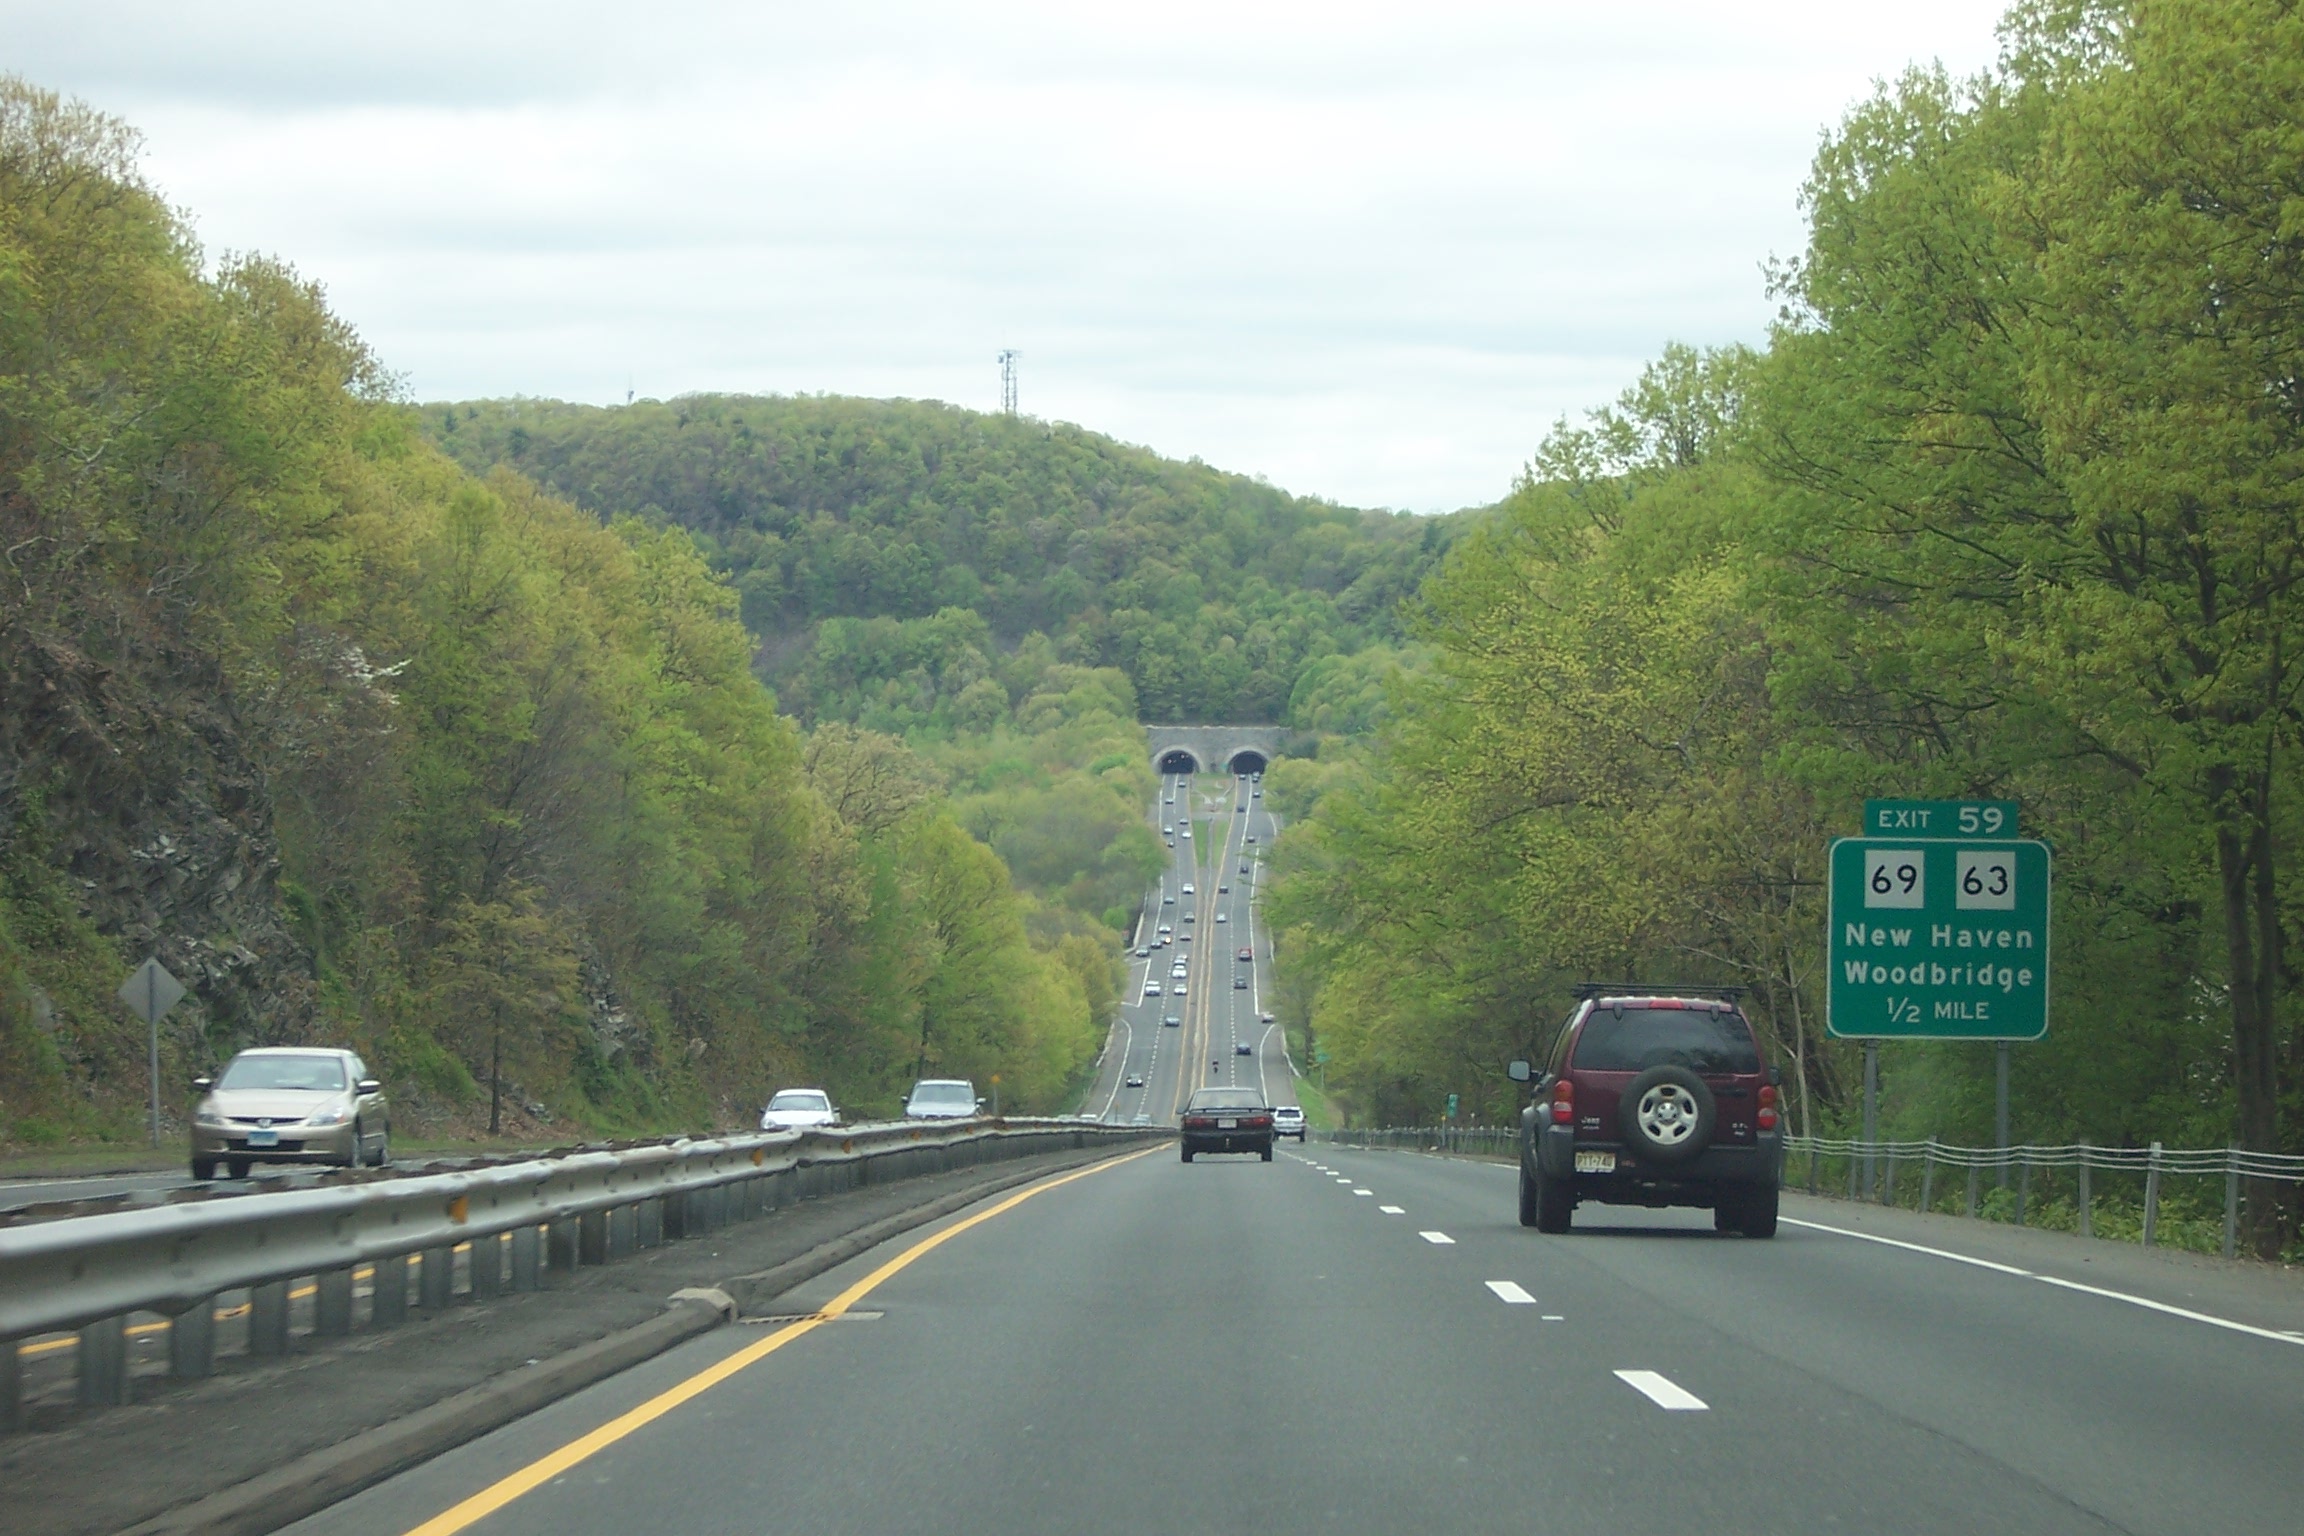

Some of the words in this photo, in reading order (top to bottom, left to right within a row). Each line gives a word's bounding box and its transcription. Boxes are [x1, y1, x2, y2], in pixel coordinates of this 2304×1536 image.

[1878, 810, 1931, 828] EXIT
[1958, 806, 2004, 834] 59
[1871, 864, 1918, 894] 69
[1962, 865, 2009, 896] 63
[1845, 923, 1912, 947] New
[1931, 924, 2034, 949] Haven
[1844, 960, 2033, 994] Woodbridge
[1934, 1002, 1990, 1020] MILE
